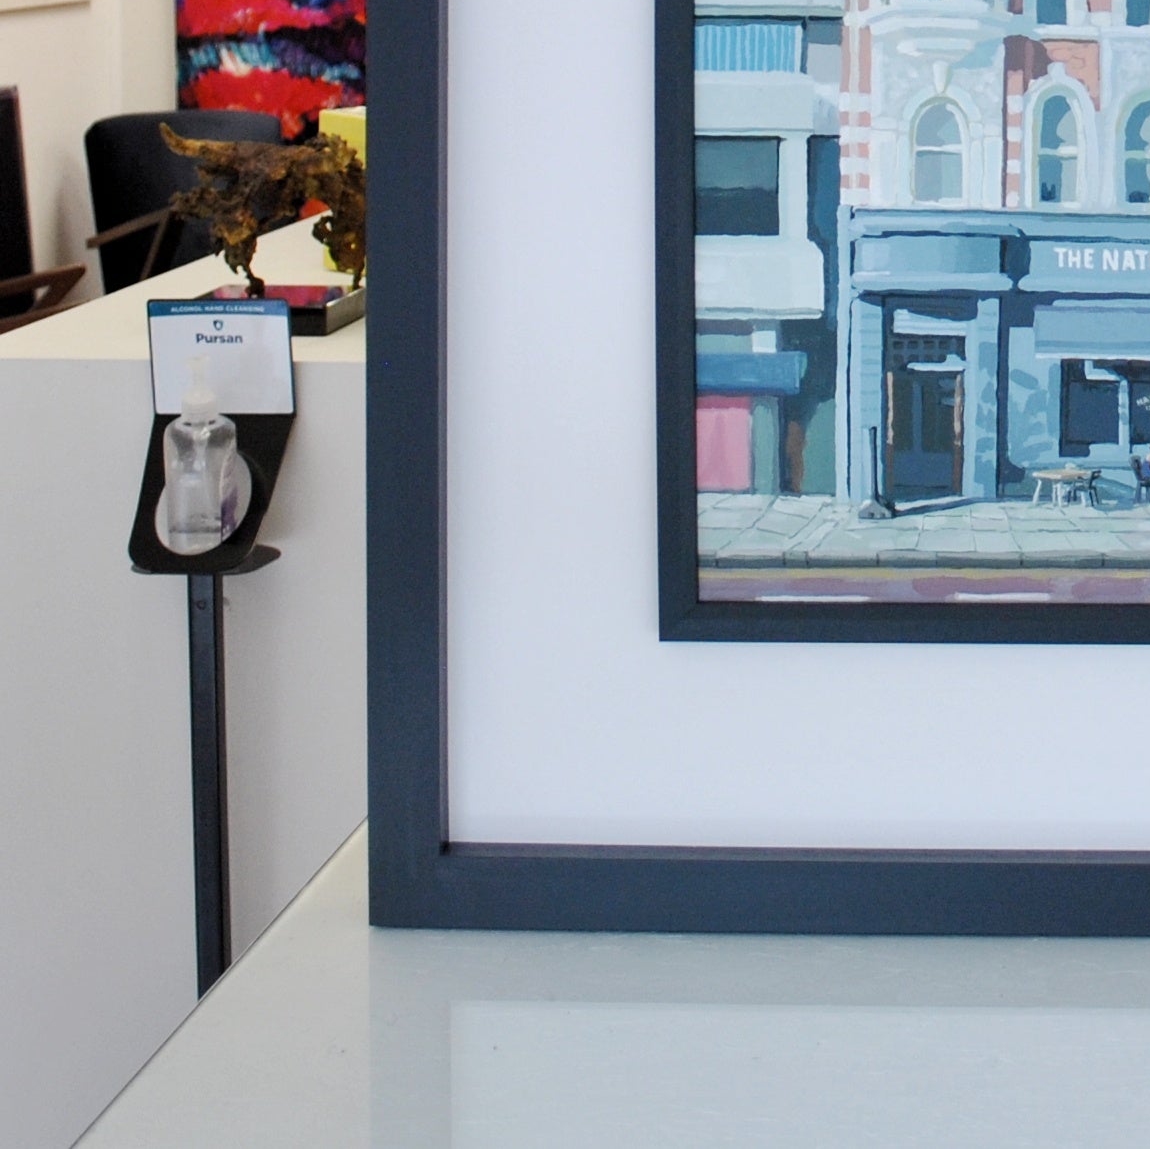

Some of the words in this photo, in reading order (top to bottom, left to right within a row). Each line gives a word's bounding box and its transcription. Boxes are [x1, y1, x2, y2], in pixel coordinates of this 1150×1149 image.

[1054, 247, 1095, 270] THE
[170, 305, 202, 313] ALCOHOL
[195, 333, 243, 344] Pursan
